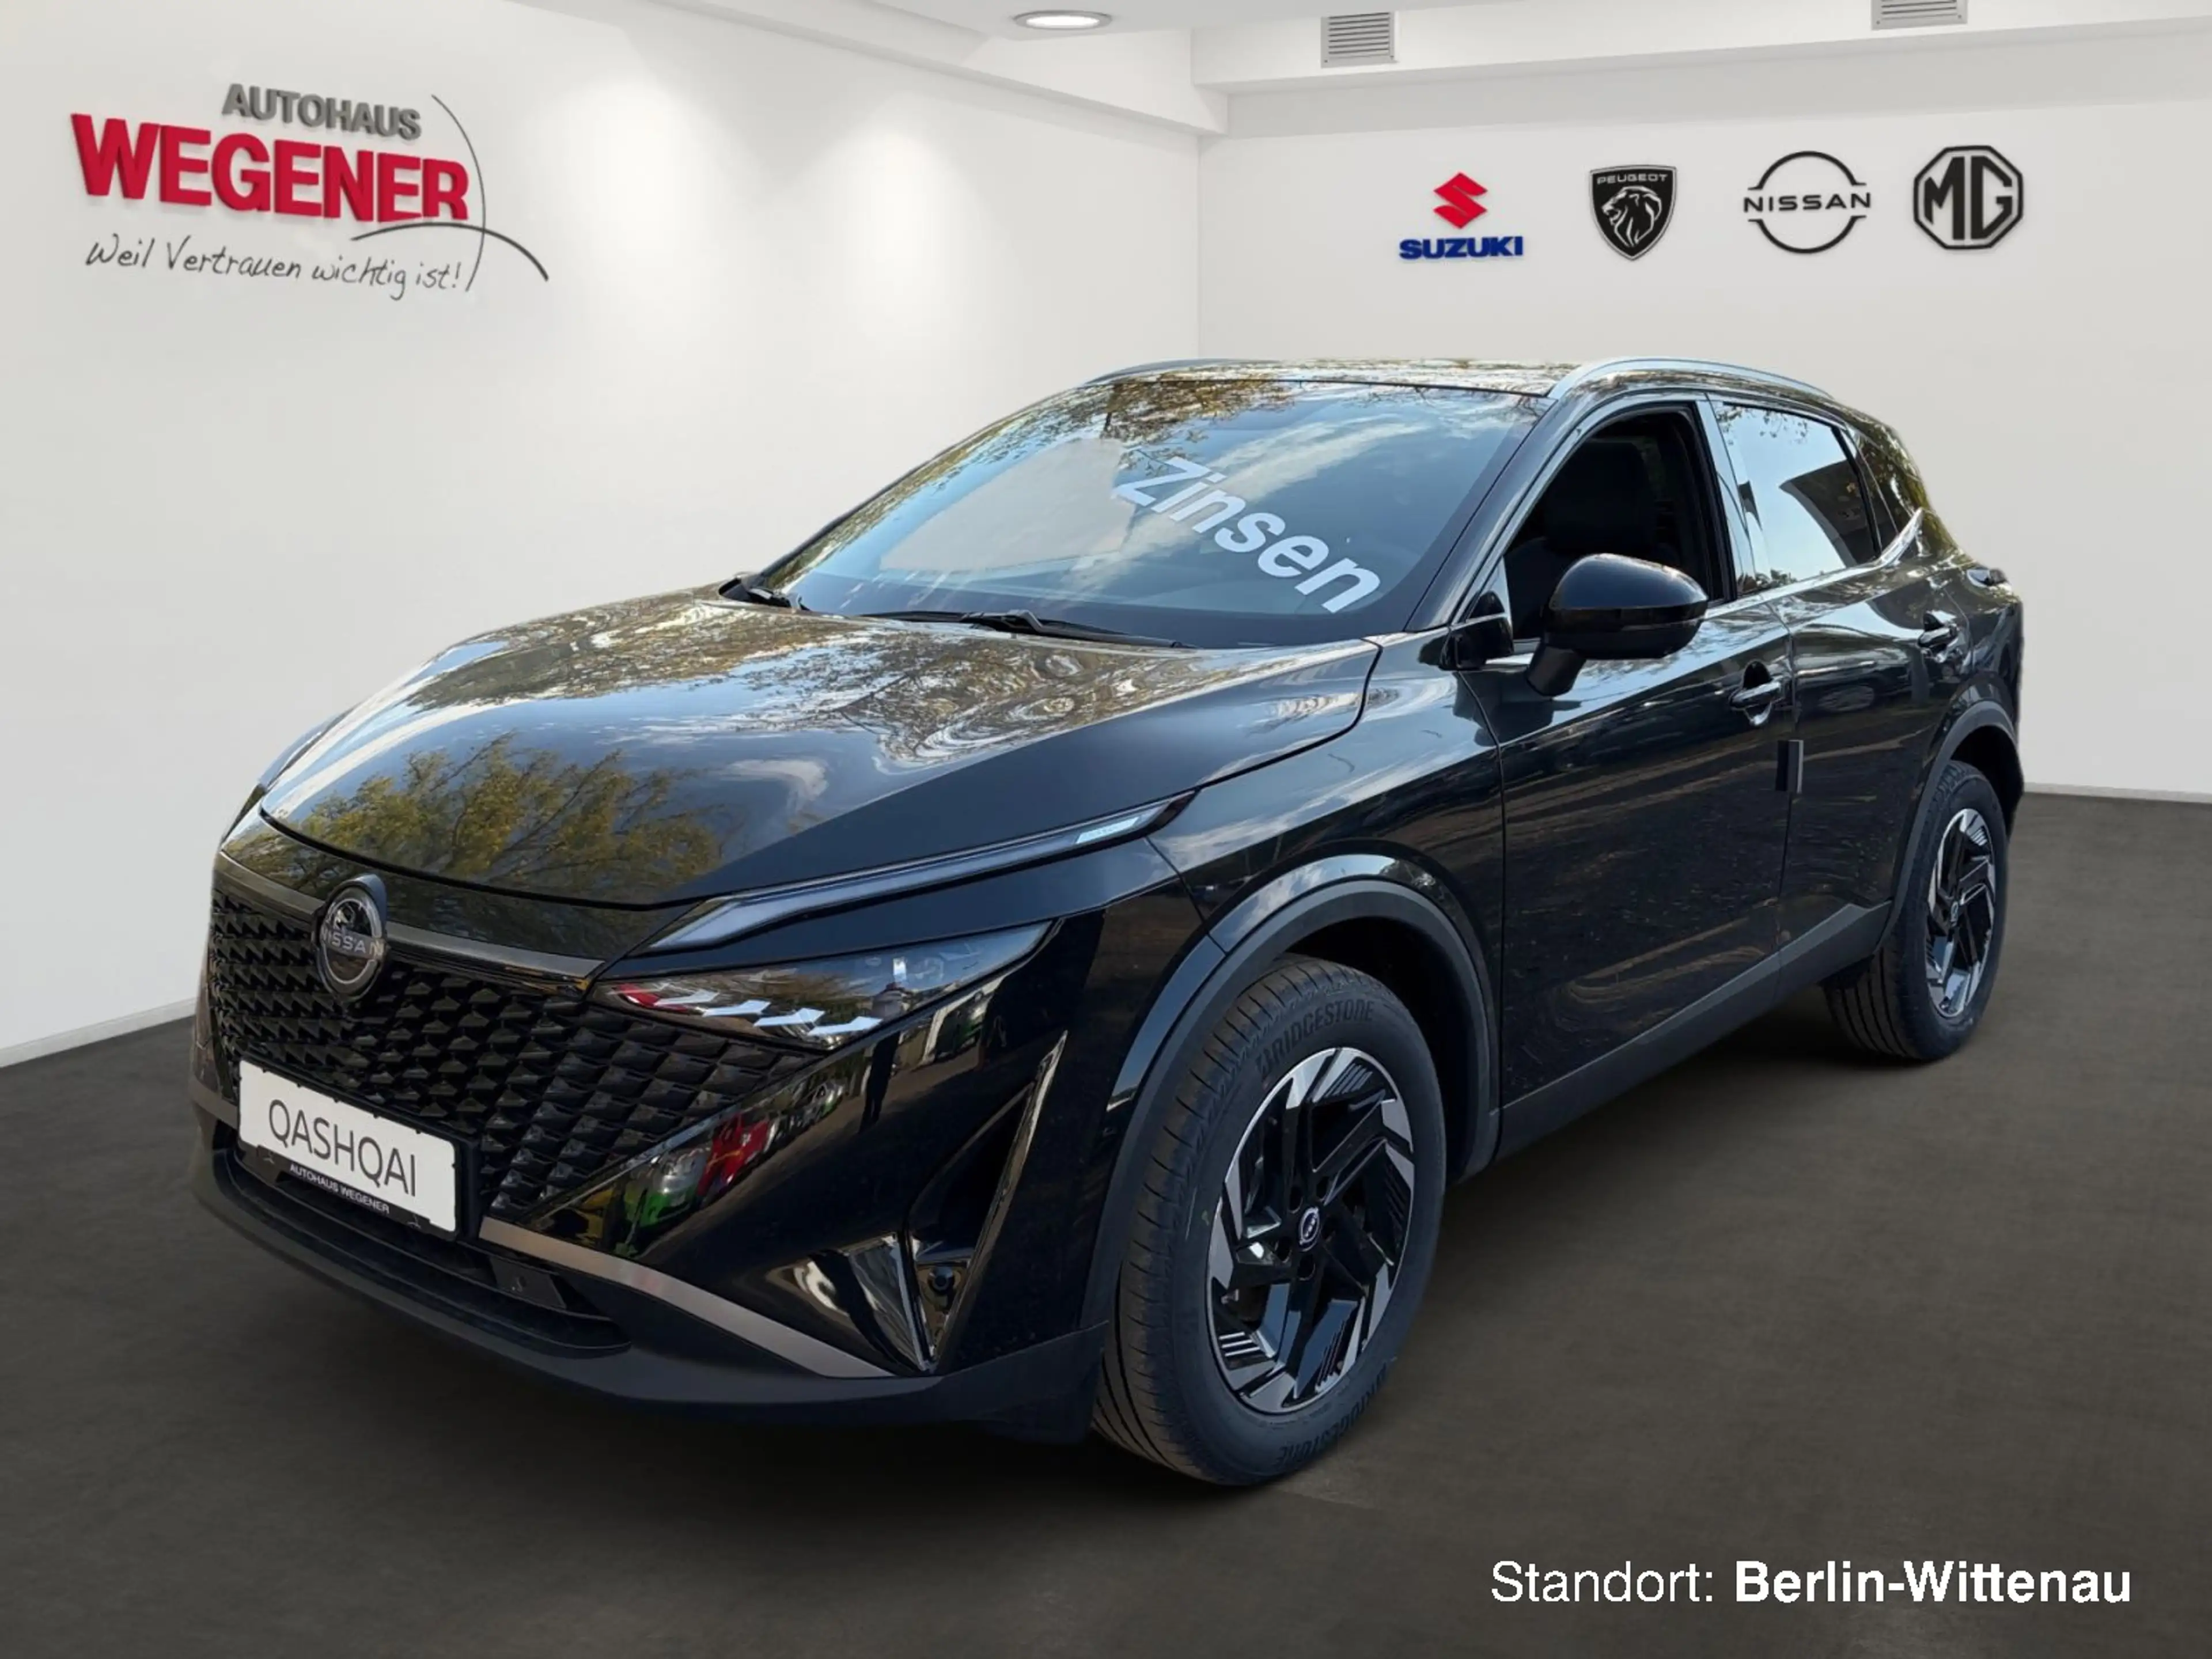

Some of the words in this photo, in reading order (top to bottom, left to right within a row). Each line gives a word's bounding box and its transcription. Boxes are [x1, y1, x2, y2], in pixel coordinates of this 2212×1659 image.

[222, 83, 422, 141] AUTOHAUS
[70, 113, 470, 223] WEGENER
[1596, 173, 1668, 185] PEUGEOT
[1922, 155, 2014, 242] MG
[1744, 192, 1872, 213] NISSAN
[85, 233, 155, 268] Weil
[166, 234, 302, 278] Vertrauen
[312, 255, 406, 301] wichtig
[415, 261, 461, 289] ist!
[1399, 236, 1524, 260] SUZUKI
[1112, 456, 1381, 613] Zinsen
[320, 924, 385, 958] NISSAN
[1255, 998, 1375, 1078] BRIDGESTONE
[268, 1099, 416, 1198] QASHQAI
[290, 1162, 339, 1194] AUTOHAUS
[340, 1185, 391, 1214] WEGENER
